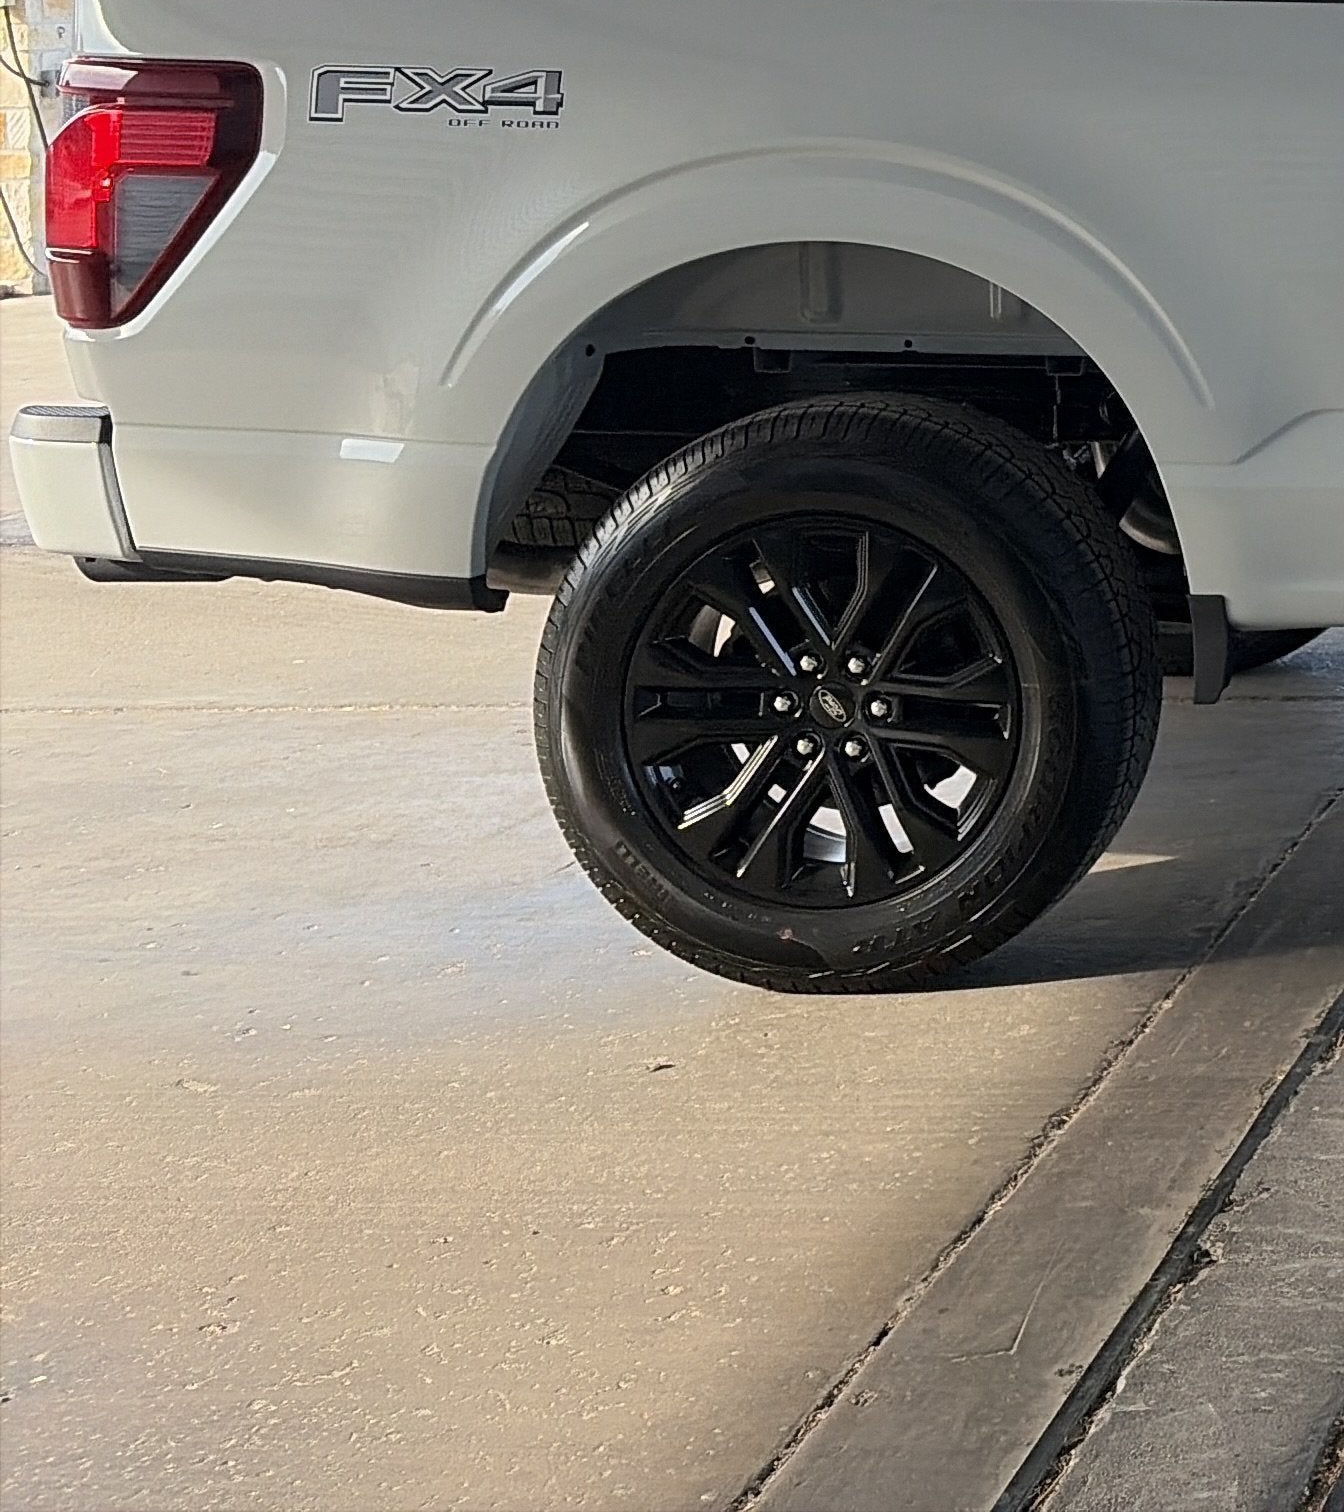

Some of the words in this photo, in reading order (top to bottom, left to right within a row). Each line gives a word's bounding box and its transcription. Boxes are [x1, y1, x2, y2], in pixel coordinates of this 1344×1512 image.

[308, 65, 565, 123] FX4
[448, 118, 491, 127] OFF
[501, 120, 560, 129] ROAD
